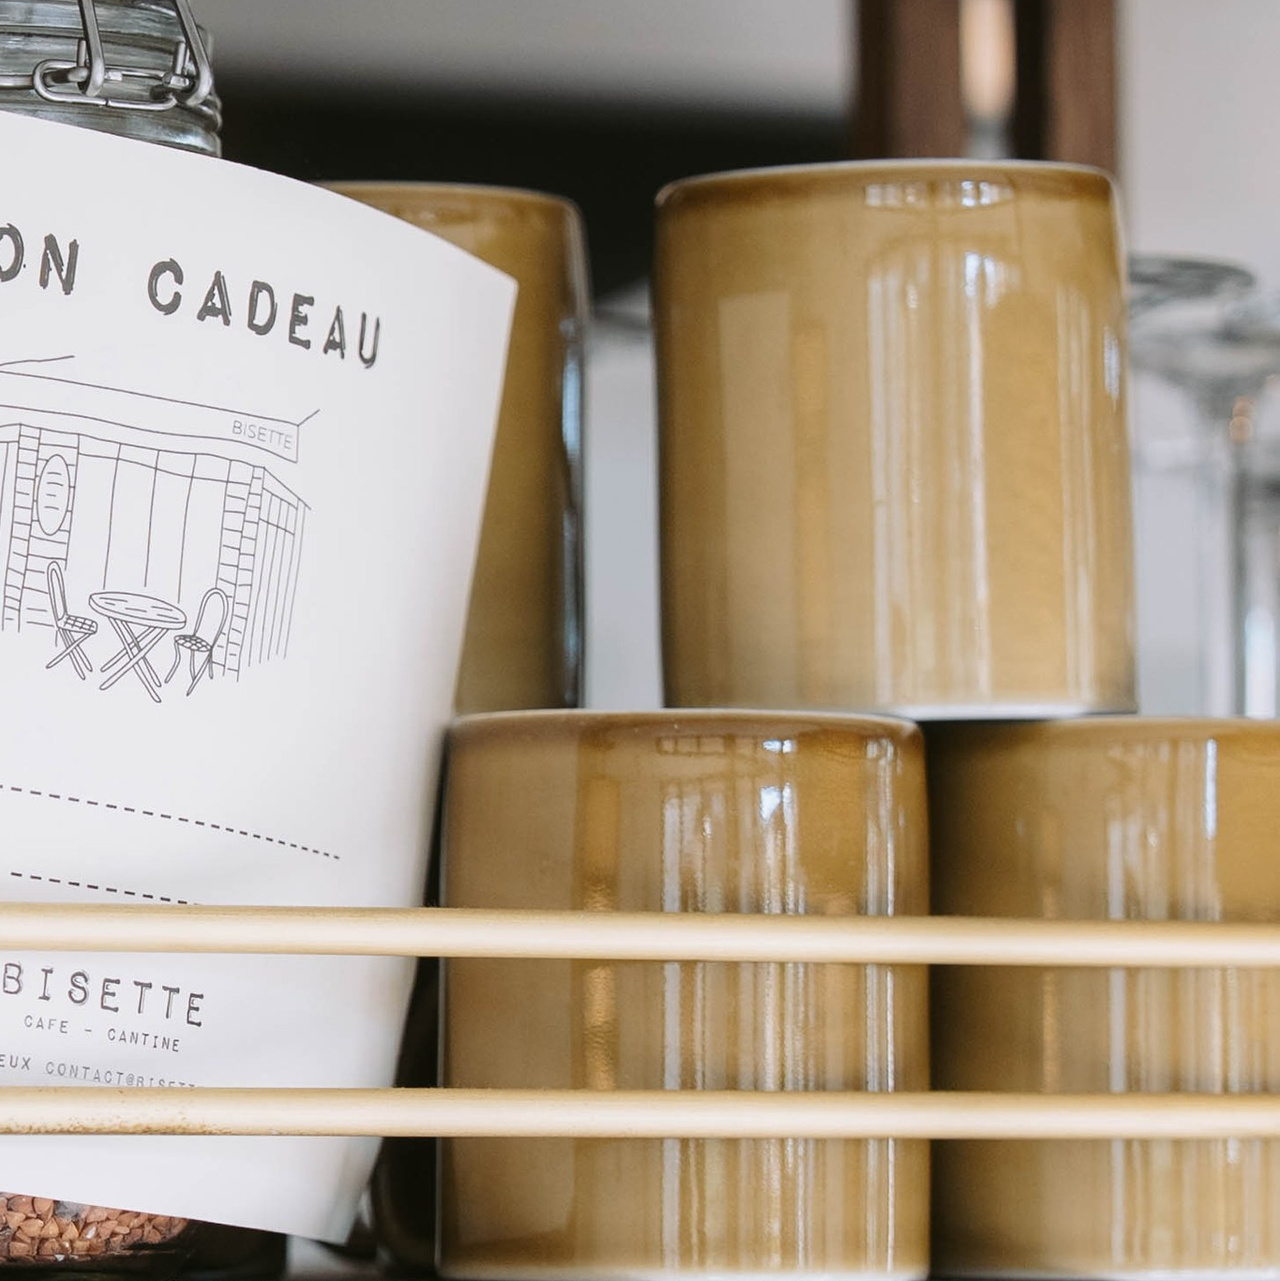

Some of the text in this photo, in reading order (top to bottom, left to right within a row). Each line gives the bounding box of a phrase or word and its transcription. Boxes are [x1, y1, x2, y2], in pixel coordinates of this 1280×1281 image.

[147, 257, 381, 370] CADEAU
[231, 419, 293, 450] BISETTE
[2, 962, 205, 1028] BISETTE
[23, 1014, 69, 1035] CAFE
[107, 1027, 181, 1053] CANTINE
